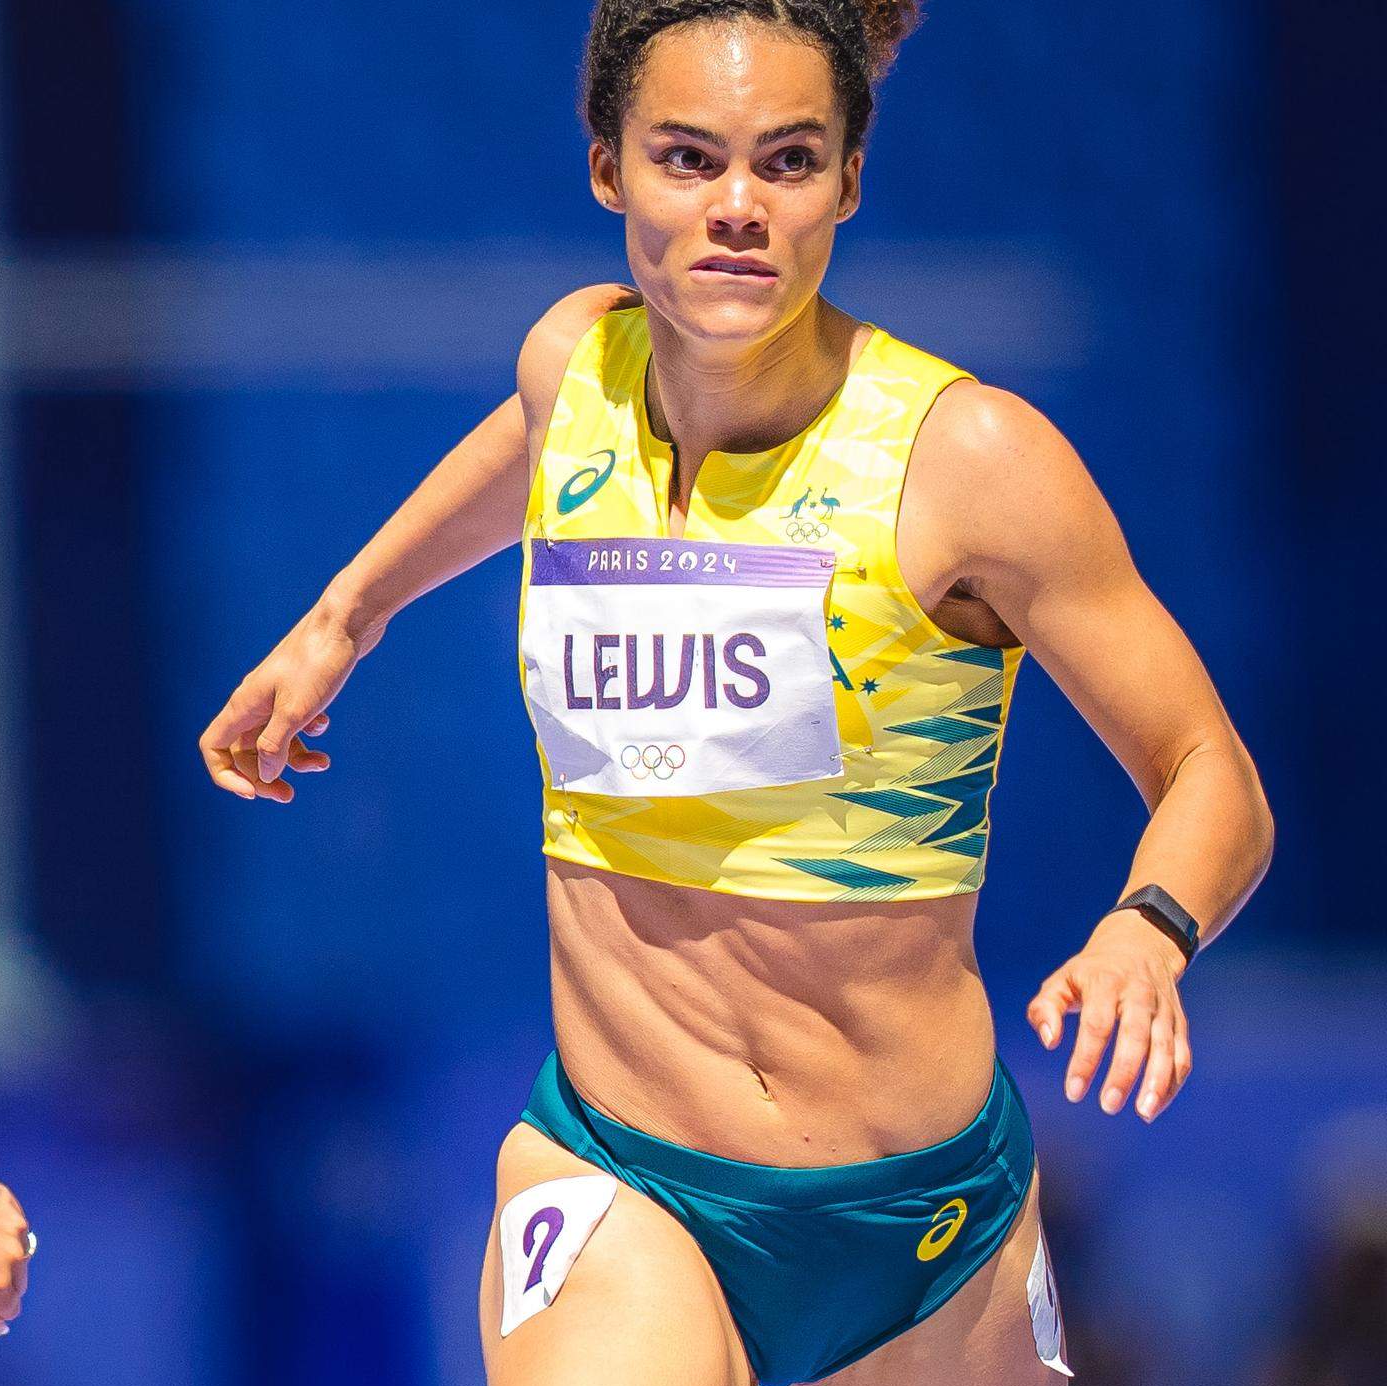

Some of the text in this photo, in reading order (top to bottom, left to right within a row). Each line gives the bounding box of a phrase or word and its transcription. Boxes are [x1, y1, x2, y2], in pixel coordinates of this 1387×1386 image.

[588, 550, 737, 574] PARIS 2024
[563, 632, 770, 709] LEWIS
